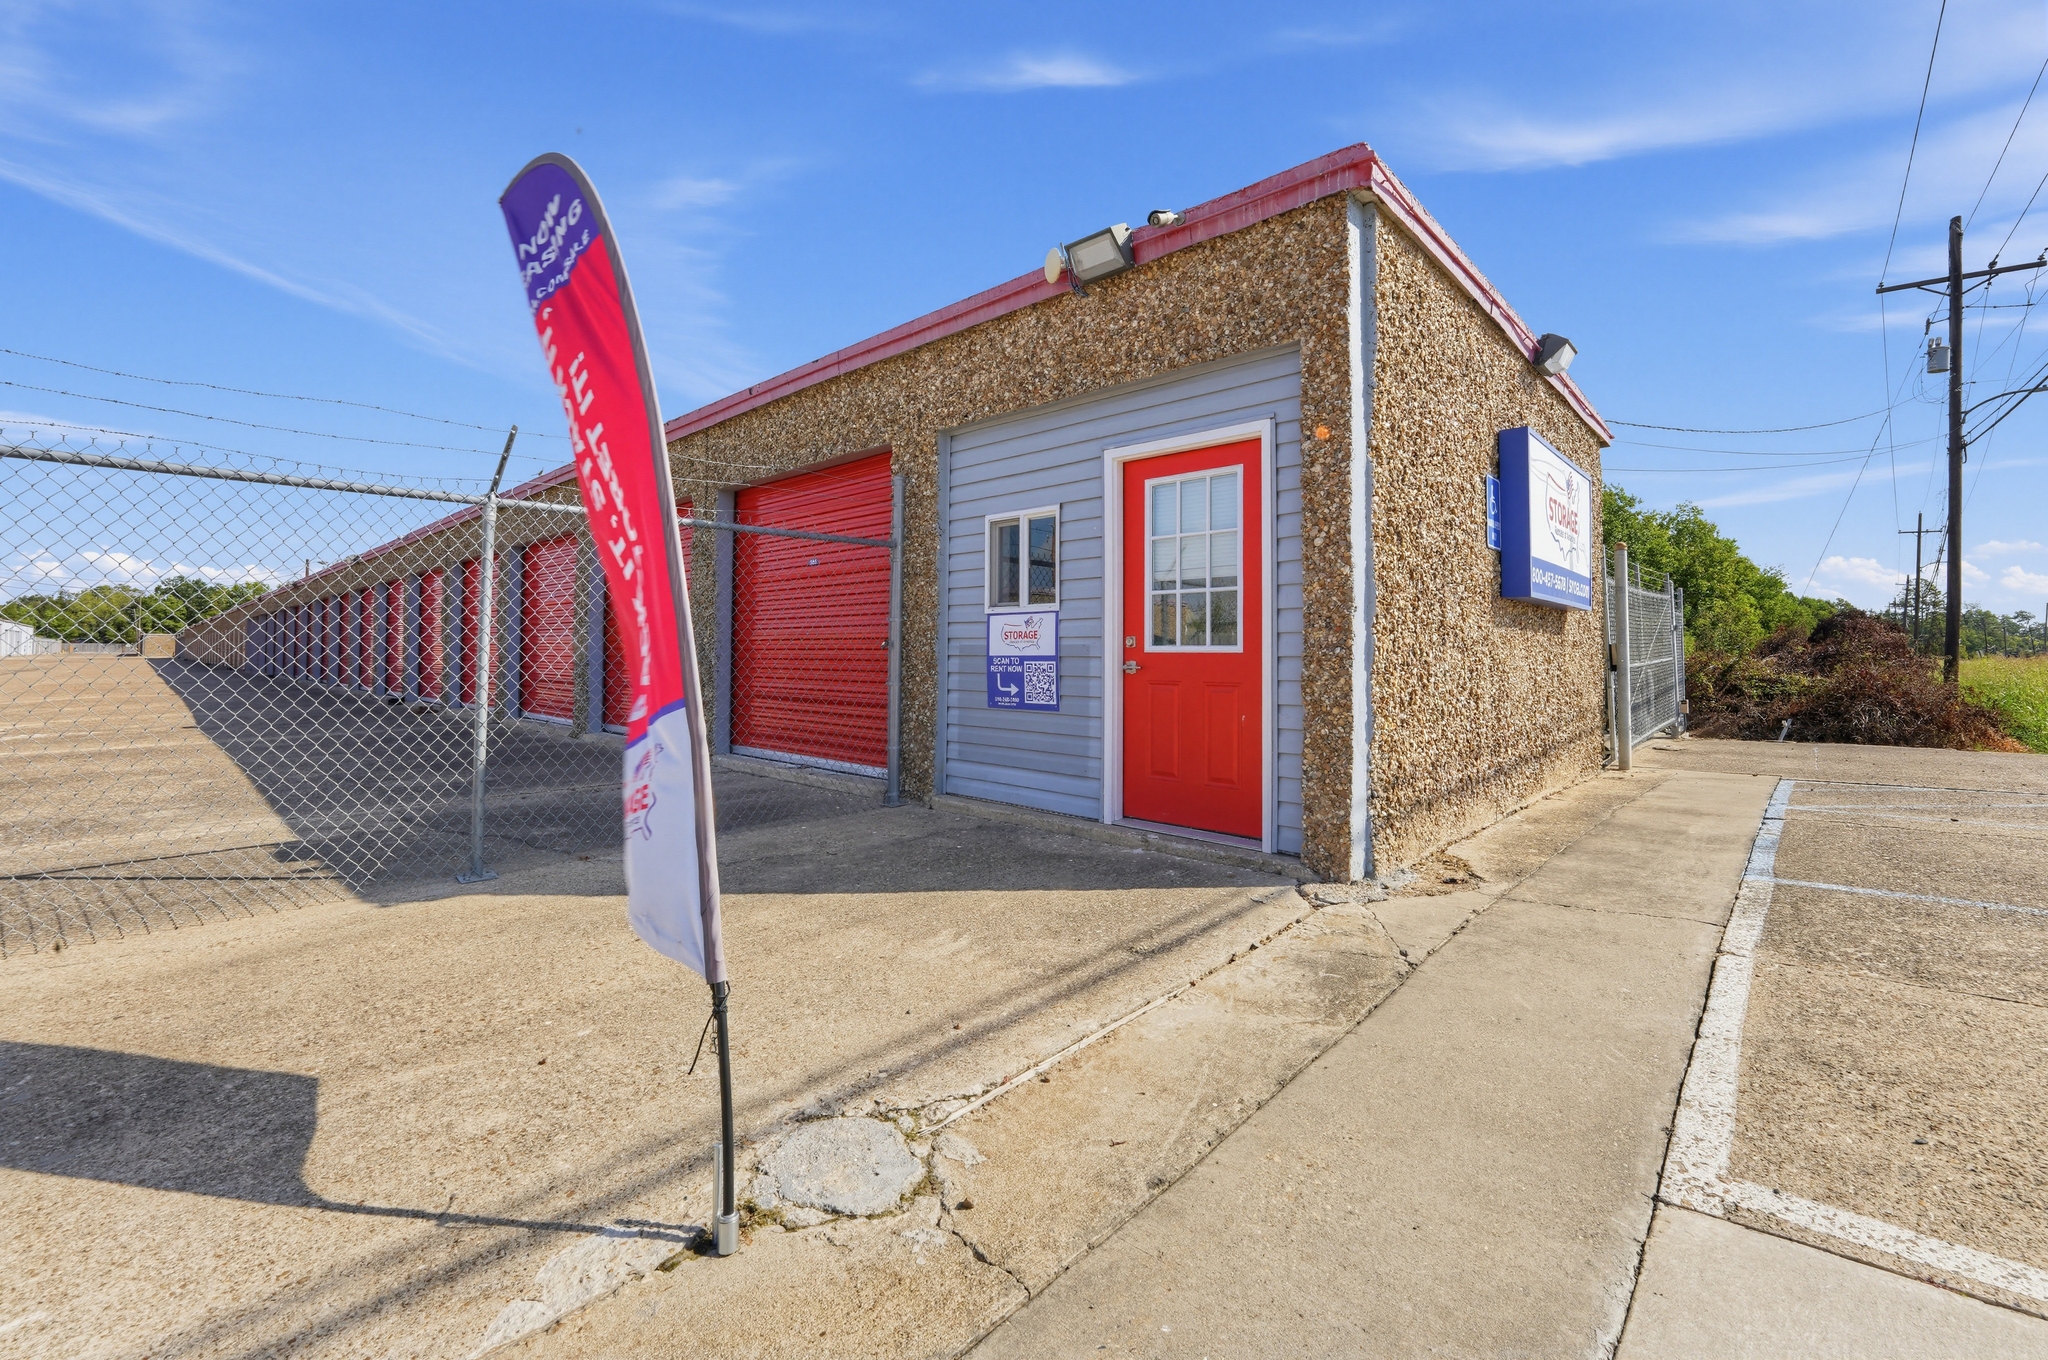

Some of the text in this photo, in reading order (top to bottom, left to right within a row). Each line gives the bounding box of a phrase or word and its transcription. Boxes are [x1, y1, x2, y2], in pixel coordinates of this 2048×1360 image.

[518, 193, 561, 260] NOW
[1548, 496, 1578, 535] STORAGE
[1004, 630, 1038, 640] STORAGE
[993, 657, 1020, 665] SCAN TO
[990, 665, 1023, 673] RENT NOW
